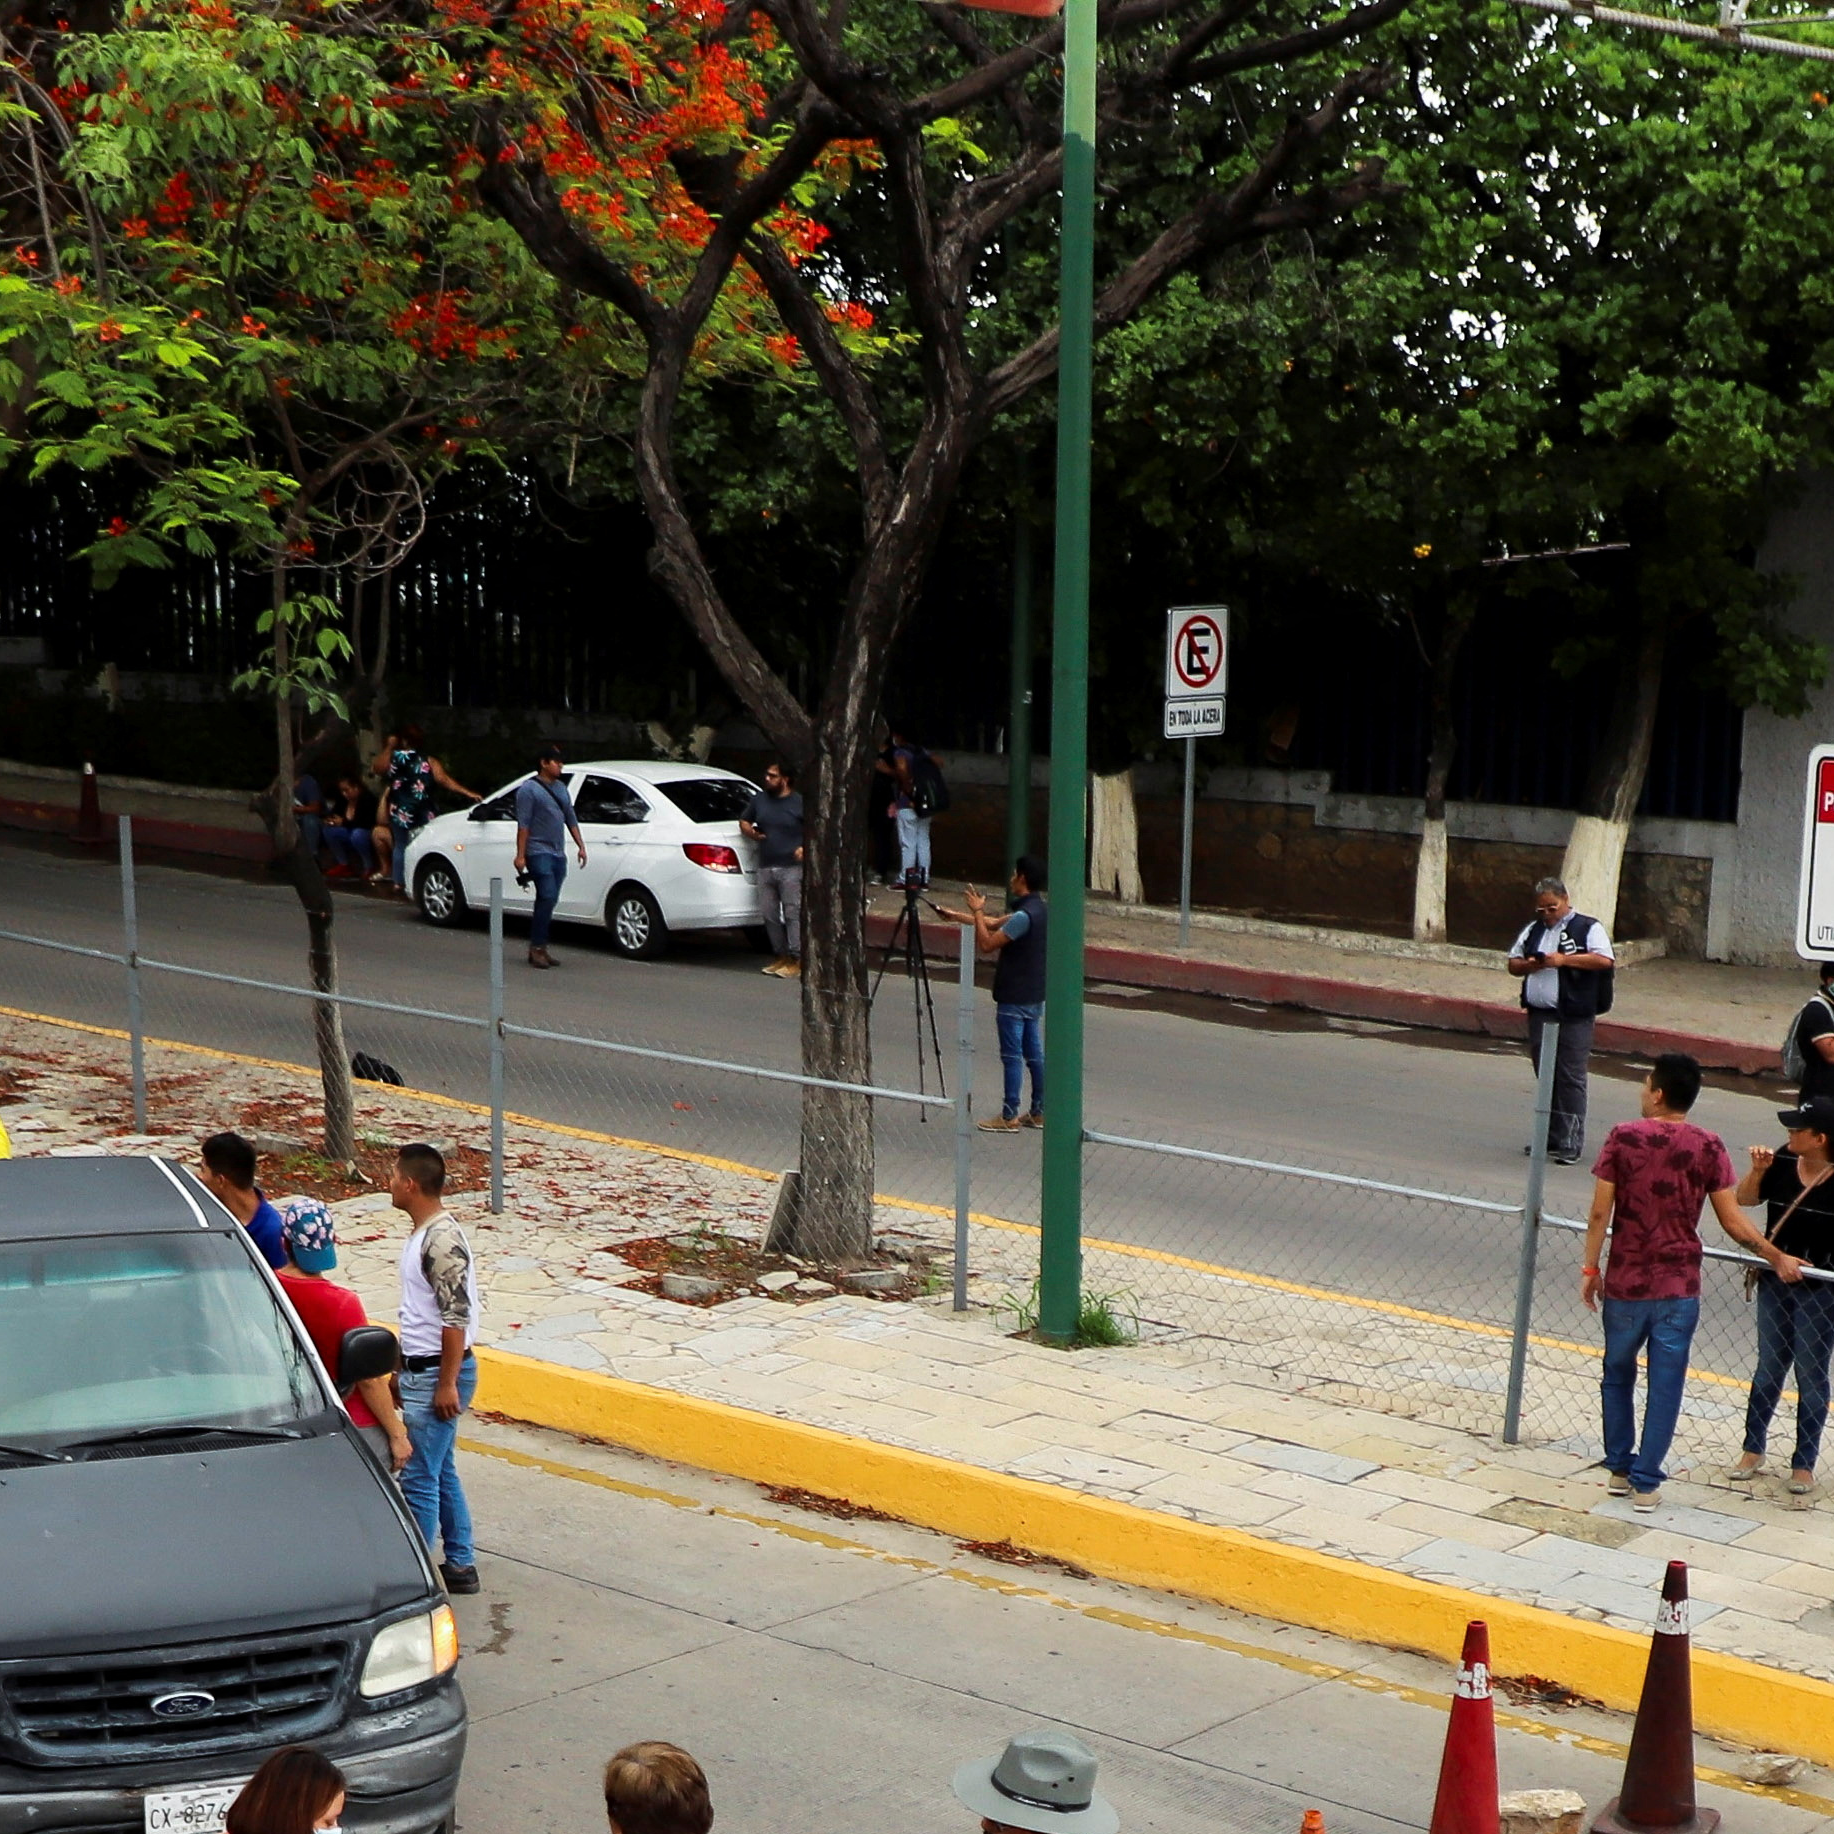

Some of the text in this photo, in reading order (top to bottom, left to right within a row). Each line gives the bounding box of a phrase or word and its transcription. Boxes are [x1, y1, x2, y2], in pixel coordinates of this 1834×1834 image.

[1169, 707, 1220, 726] EN TODA LA ACERA
[167, 1697, 202, 1713] Ford
[150, 1803, 228, 1829] CX-8276
